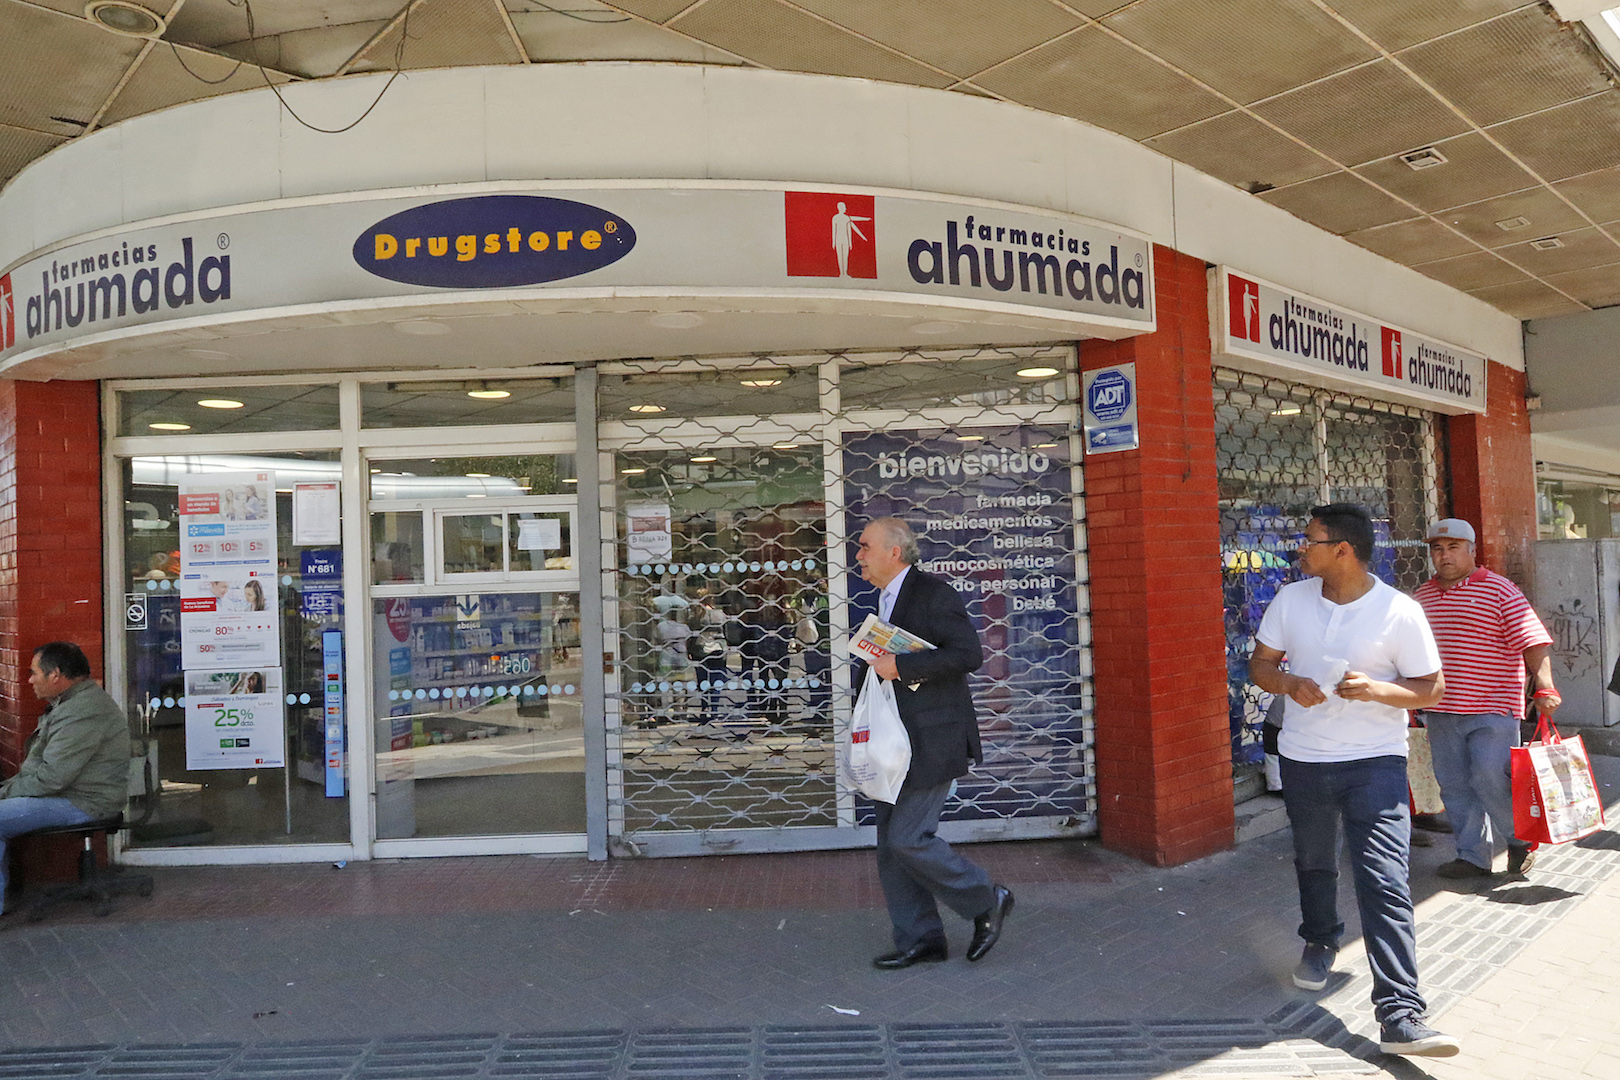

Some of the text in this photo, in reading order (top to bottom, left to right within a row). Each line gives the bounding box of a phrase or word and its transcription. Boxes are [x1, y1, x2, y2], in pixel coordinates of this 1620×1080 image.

[375, 227, 602, 262] Drugstore
[966, 215, 1090, 256] farmacias
[53, 241, 157, 283] farmacias
[907, 220, 1144, 310] ahumada
[27, 237, 231, 339] ahumada
[1291, 296, 1343, 331] farmacias
[1270, 300, 1368, 371] ahumada
[1422, 343, 1455, 366] farmacias
[1409, 346, 1471, 398] ahumada
[1095, 385, 1124, 406] ADT
[879, 446, 1049, 478] bienvenido
[976, 492, 1051, 508] farmacia
[926, 515, 1052, 530] medicamentos
[993, 535, 1054, 549] belleza
[981, 574, 1055, 594] personal
[1013, 594, 1056, 610] bebé
